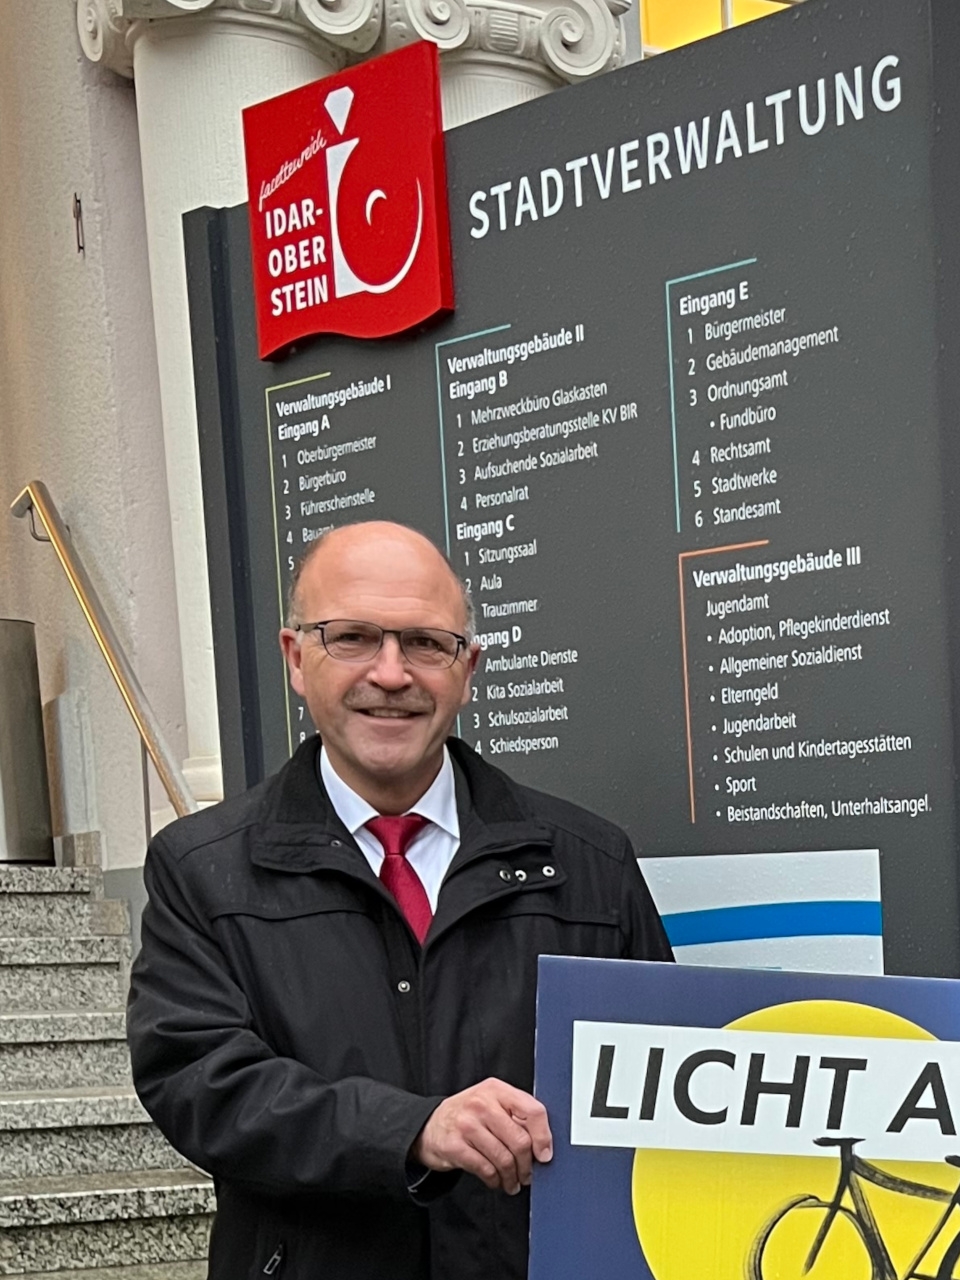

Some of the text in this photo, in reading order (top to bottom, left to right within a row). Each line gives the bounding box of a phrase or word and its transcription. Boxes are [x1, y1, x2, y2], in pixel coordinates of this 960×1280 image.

[469, 55, 902, 239] STADTVERWALTUNG
[259, 129, 327, 212] facettenreich
[265, 198, 323, 239] IDAR-
[268, 235, 326, 278] OBER
[270, 275, 328, 317] STEIN
[680, 281, 748, 315] Eingang E
[688, 308, 786, 344] 1 Bürgermeister
[447, 324, 584, 374] Verwaltungsgebäude II
[688, 326, 839, 375] 2 Gebäudemanagement
[276, 374, 391, 417] Verwaltungsgebäude I
[450, 370, 508, 399] Eingang B
[690, 370, 788, 406] 3 Ordnungsamt
[457, 383, 607, 428] 1 Mehrzweckbüro Glaskasten
[720, 407, 776, 430] Fundbüro
[278, 414, 330, 441] Eingang A
[458, 402, 638, 456] 2 Erziehungsberatungsstelle KV BIR
[282, 437, 376, 468] 1 Oberbürgermeister
[459, 442, 598, 484] 3 Aufsuchende Sozialarbeit
[692, 437, 771, 466] 4 Rechtsamt
[284, 469, 346, 494] 2 Bürgerbüro
[694, 467, 777, 497] 5 Stadtwerke
[285, 488, 375, 520] 3 Führerscheinstelle
[461, 486, 529, 510] 4 Personalrat
[695, 499, 781, 527] 6 Standesamt
[286, 531, 293, 544] 4
[456, 514, 515, 541] Eingang C
[288, 556, 294, 570] 5
[465, 539, 537, 566] 1 Sitzungssaal
[693, 546, 861, 588] Verwaltungsgebäude III
[465, 574, 502, 593] 2 Aula
[481, 599, 537, 618] Trauzimmer
[706, 594, 769, 619] Jugendamt
[472, 626, 521, 651] ngang D
[718, 609, 890, 646] Adoption, Pflegekinderdienst
[485, 649, 578, 672] Ambulante Dienste
[720, 644, 862, 678] Allgemeiner Sozialdienst
[472, 677, 564, 701] 2 Kita Sozialarbeit
[722, 682, 778, 706] Elterngeld
[298, 706, 304, 720] 7
[474, 706, 568, 728] 3 Schulsozialarbeit
[723, 713, 797, 737] Jugendarbeit
[475, 736, 558, 755] 4 Schiedsperson
[724, 735, 911, 763] Schulen und Kindertagesstätten
[726, 777, 757, 796] Sport
[728, 801, 827, 822] Beistandschaften,
[589, 1044, 867, 1130] LICHT
